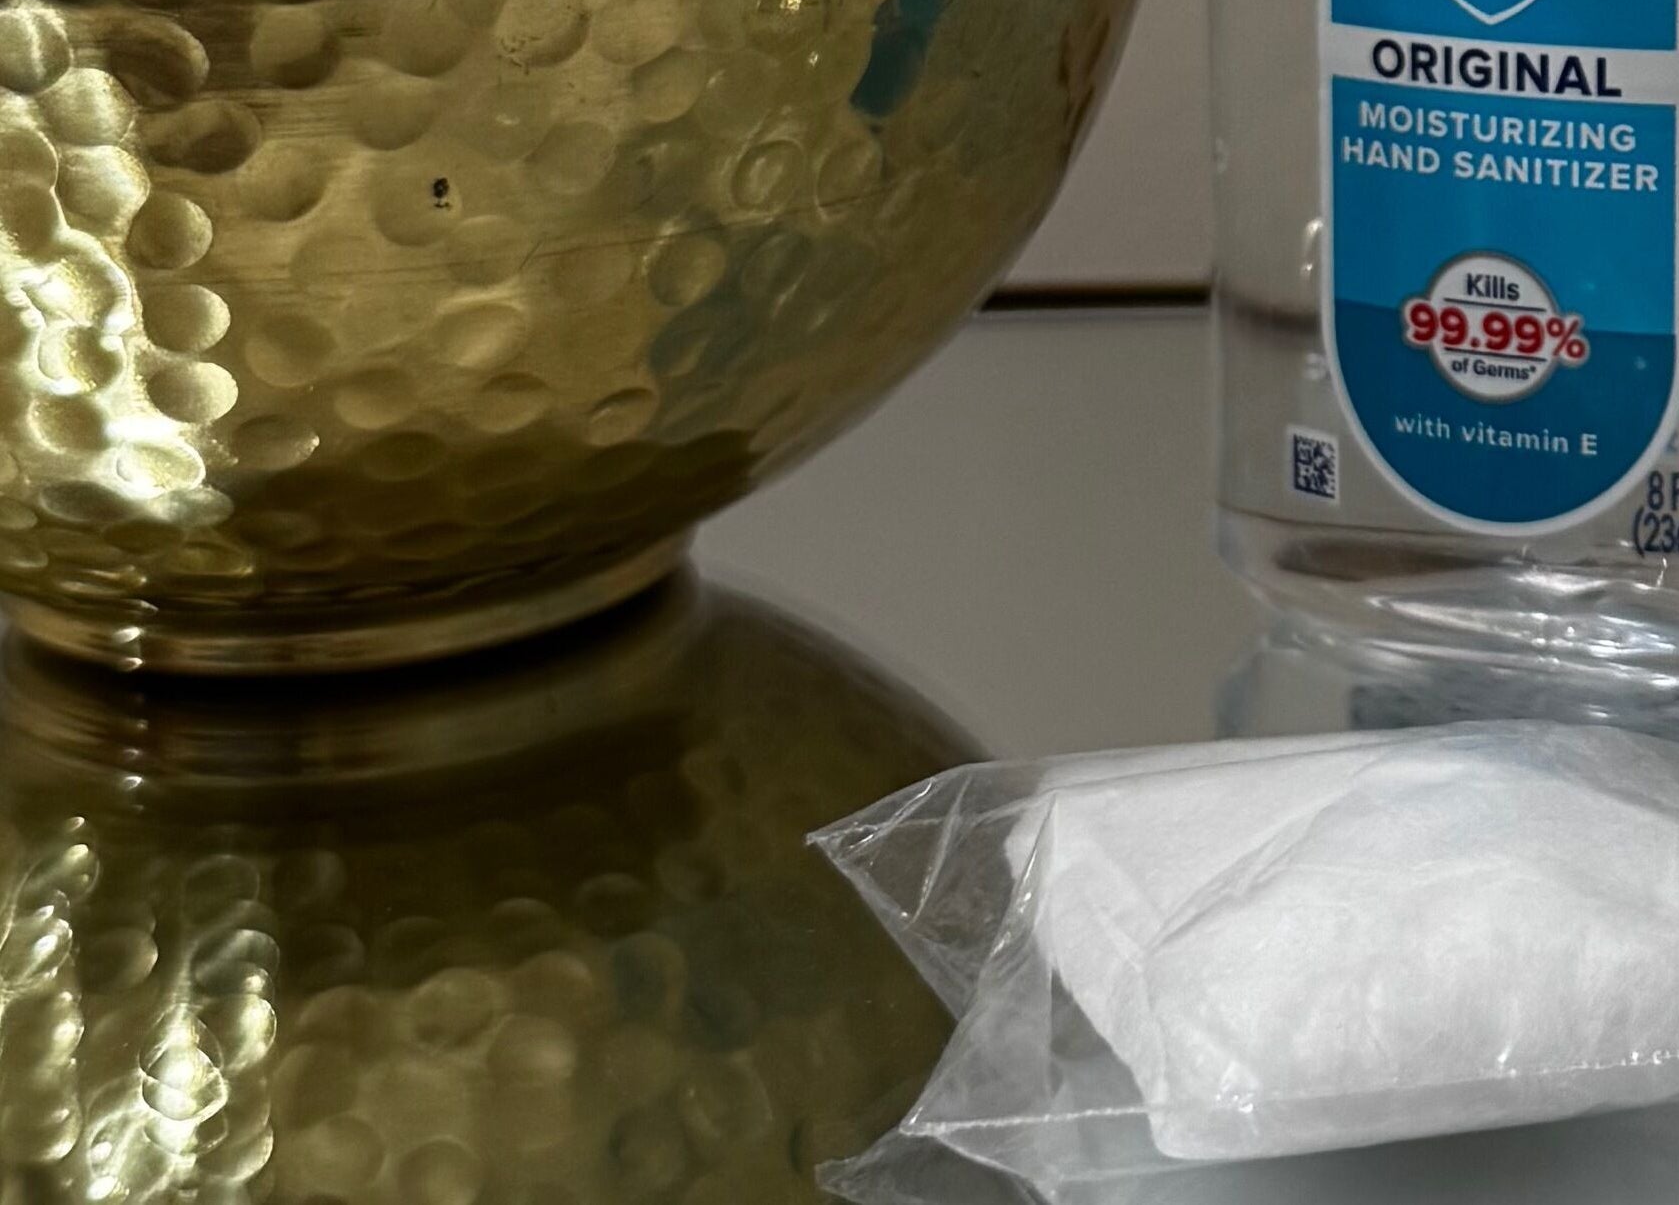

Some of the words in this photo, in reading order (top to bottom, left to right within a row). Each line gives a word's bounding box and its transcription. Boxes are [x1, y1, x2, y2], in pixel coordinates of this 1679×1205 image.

[1371, 38, 1623, 98] ORIGINAL
[1358, 99, 1637, 153] MOISTURIZING
[1341, 136, 1441, 175] HAND
[1452, 150, 1660, 192] SANITIZER
[1465, 272, 1521, 302] Kills
[1407, 302, 1588, 361] 99.99%
[1450, 358, 1470, 376] of
[1394, 413, 1451, 442] with
[1462, 419, 1570, 455] vitamin
[1580, 433, 1598, 456] E
[1646, 475, 1666, 514] 8
